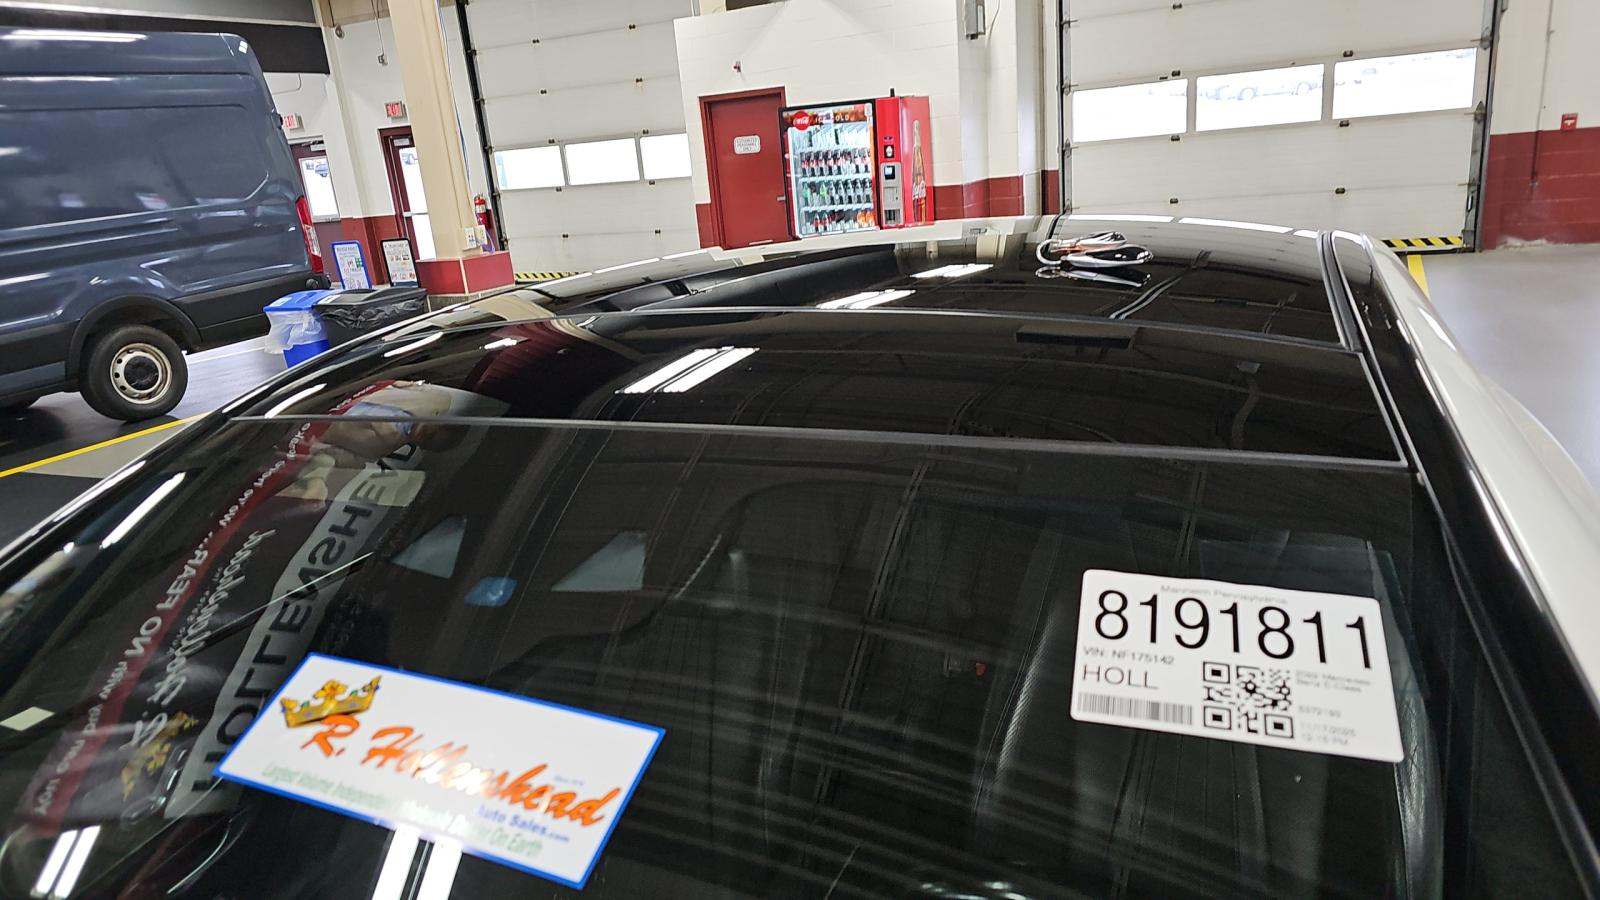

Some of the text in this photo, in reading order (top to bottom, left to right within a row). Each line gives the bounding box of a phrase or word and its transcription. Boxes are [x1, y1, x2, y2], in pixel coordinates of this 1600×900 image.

[1094, 589, 1372, 669] 8191811
[1083, 664, 1158, 689] HOLL
[301, 714, 360, 758] R.
[360, 726, 621, 827] Hollenshead
